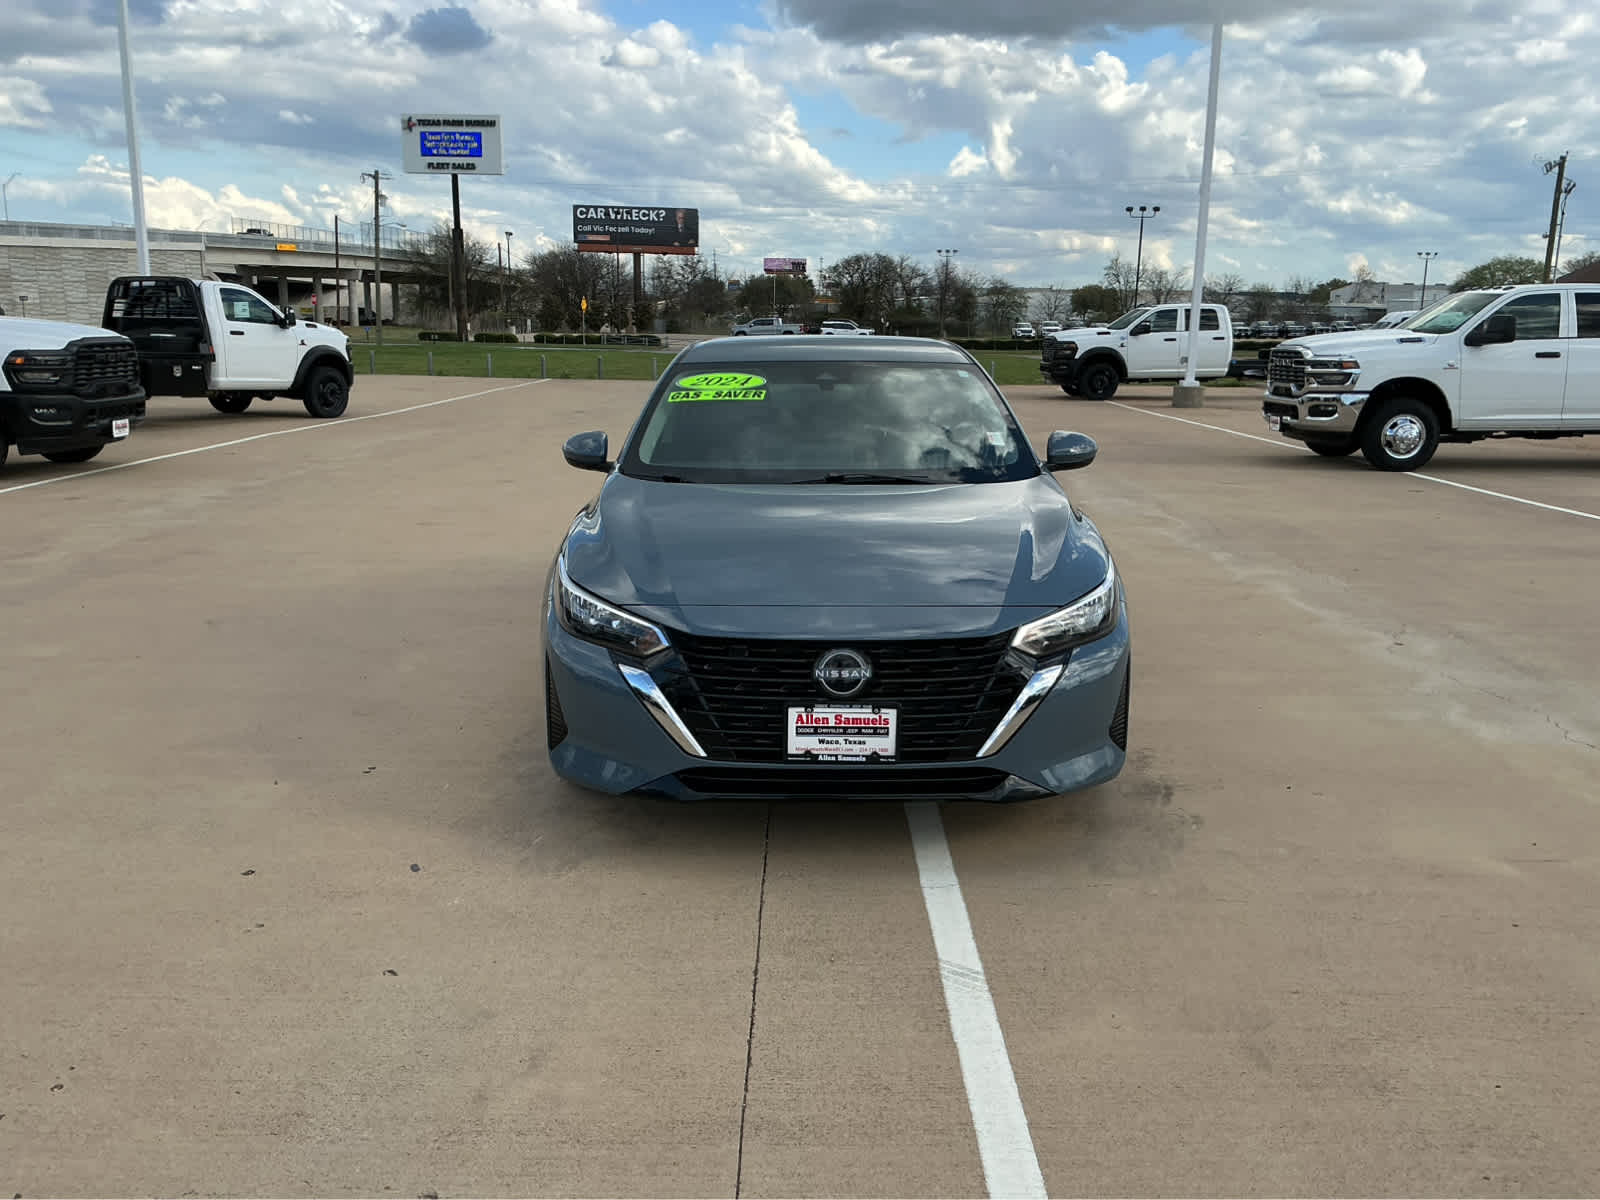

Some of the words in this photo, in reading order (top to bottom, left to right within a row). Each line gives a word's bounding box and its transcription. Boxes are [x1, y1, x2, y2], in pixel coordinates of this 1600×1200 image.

[416, 119, 441, 127] TEXAS
[442, 119, 464, 127] FARM
[465, 120, 496, 128] BUREAU
[427, 162, 450, 170] FLEET
[451, 163, 476, 171] SALES
[576, 207, 605, 219] CAR
[608, 208, 666, 221] WRECK?
[631, 226, 656, 235] Today!
[689, 376, 753, 387] 2024
[671, 391, 702, 400] GAS
[712, 390, 764, 399] SAVER
[815, 669, 870, 678] NISSAN
[795, 713, 830, 725] Allen
[834, 713, 890, 726] Samuels
[818, 738, 841, 746] Waco,
[843, 738, 867, 746] Texas
